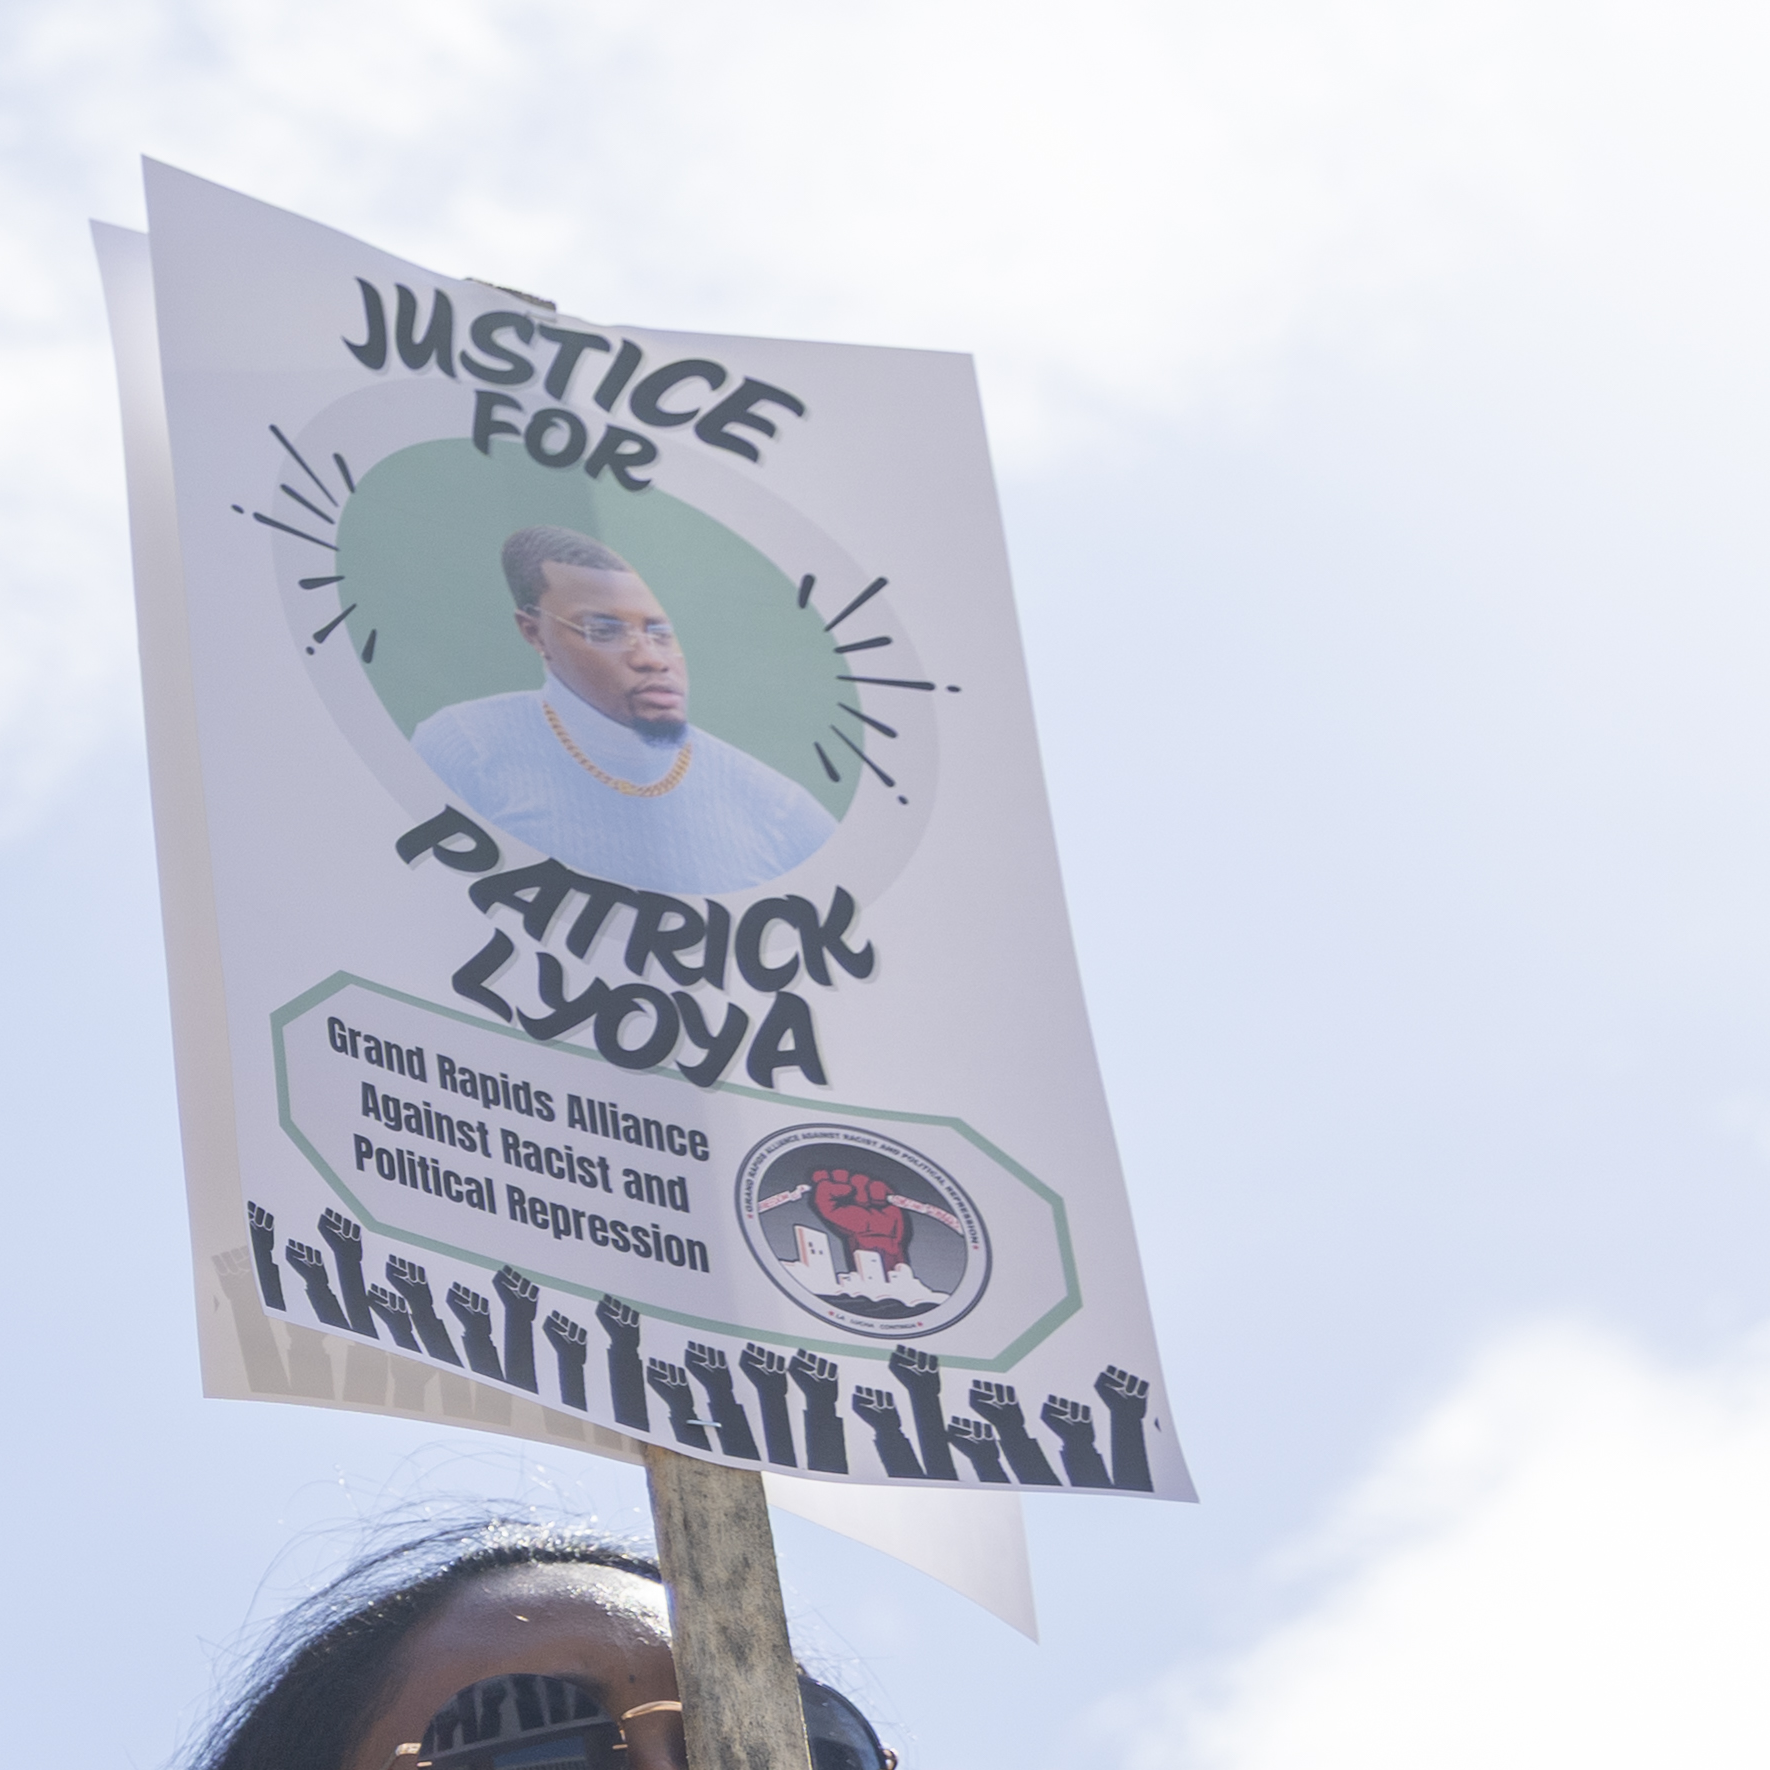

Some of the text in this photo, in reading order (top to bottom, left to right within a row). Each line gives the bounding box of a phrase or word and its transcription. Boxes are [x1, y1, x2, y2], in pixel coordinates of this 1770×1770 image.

[341, 277, 805, 462] JUSTICE
[472, 391, 658, 491] FOR
[395, 805, 875, 992] PATRICK
[452, 940, 827, 1086] LYOYA
[327, 1016, 710, 1161] Grand Rapids Alliance
[361, 1081, 691, 1213] Against Racist and
[353, 1133, 711, 1273] Political Repression
[744, 1178, 754, 1213] GRAND
[764, 1134, 801, 1154] ALLIANCE
[801, 1131, 840, 1140] AGAINST
[842, 1133, 878, 1147] RACIST
[879, 1143, 901, 1156] AND
[901, 1152, 948, 1187] POLITICAL
[944, 1185, 980, 1244] REPRESSION
